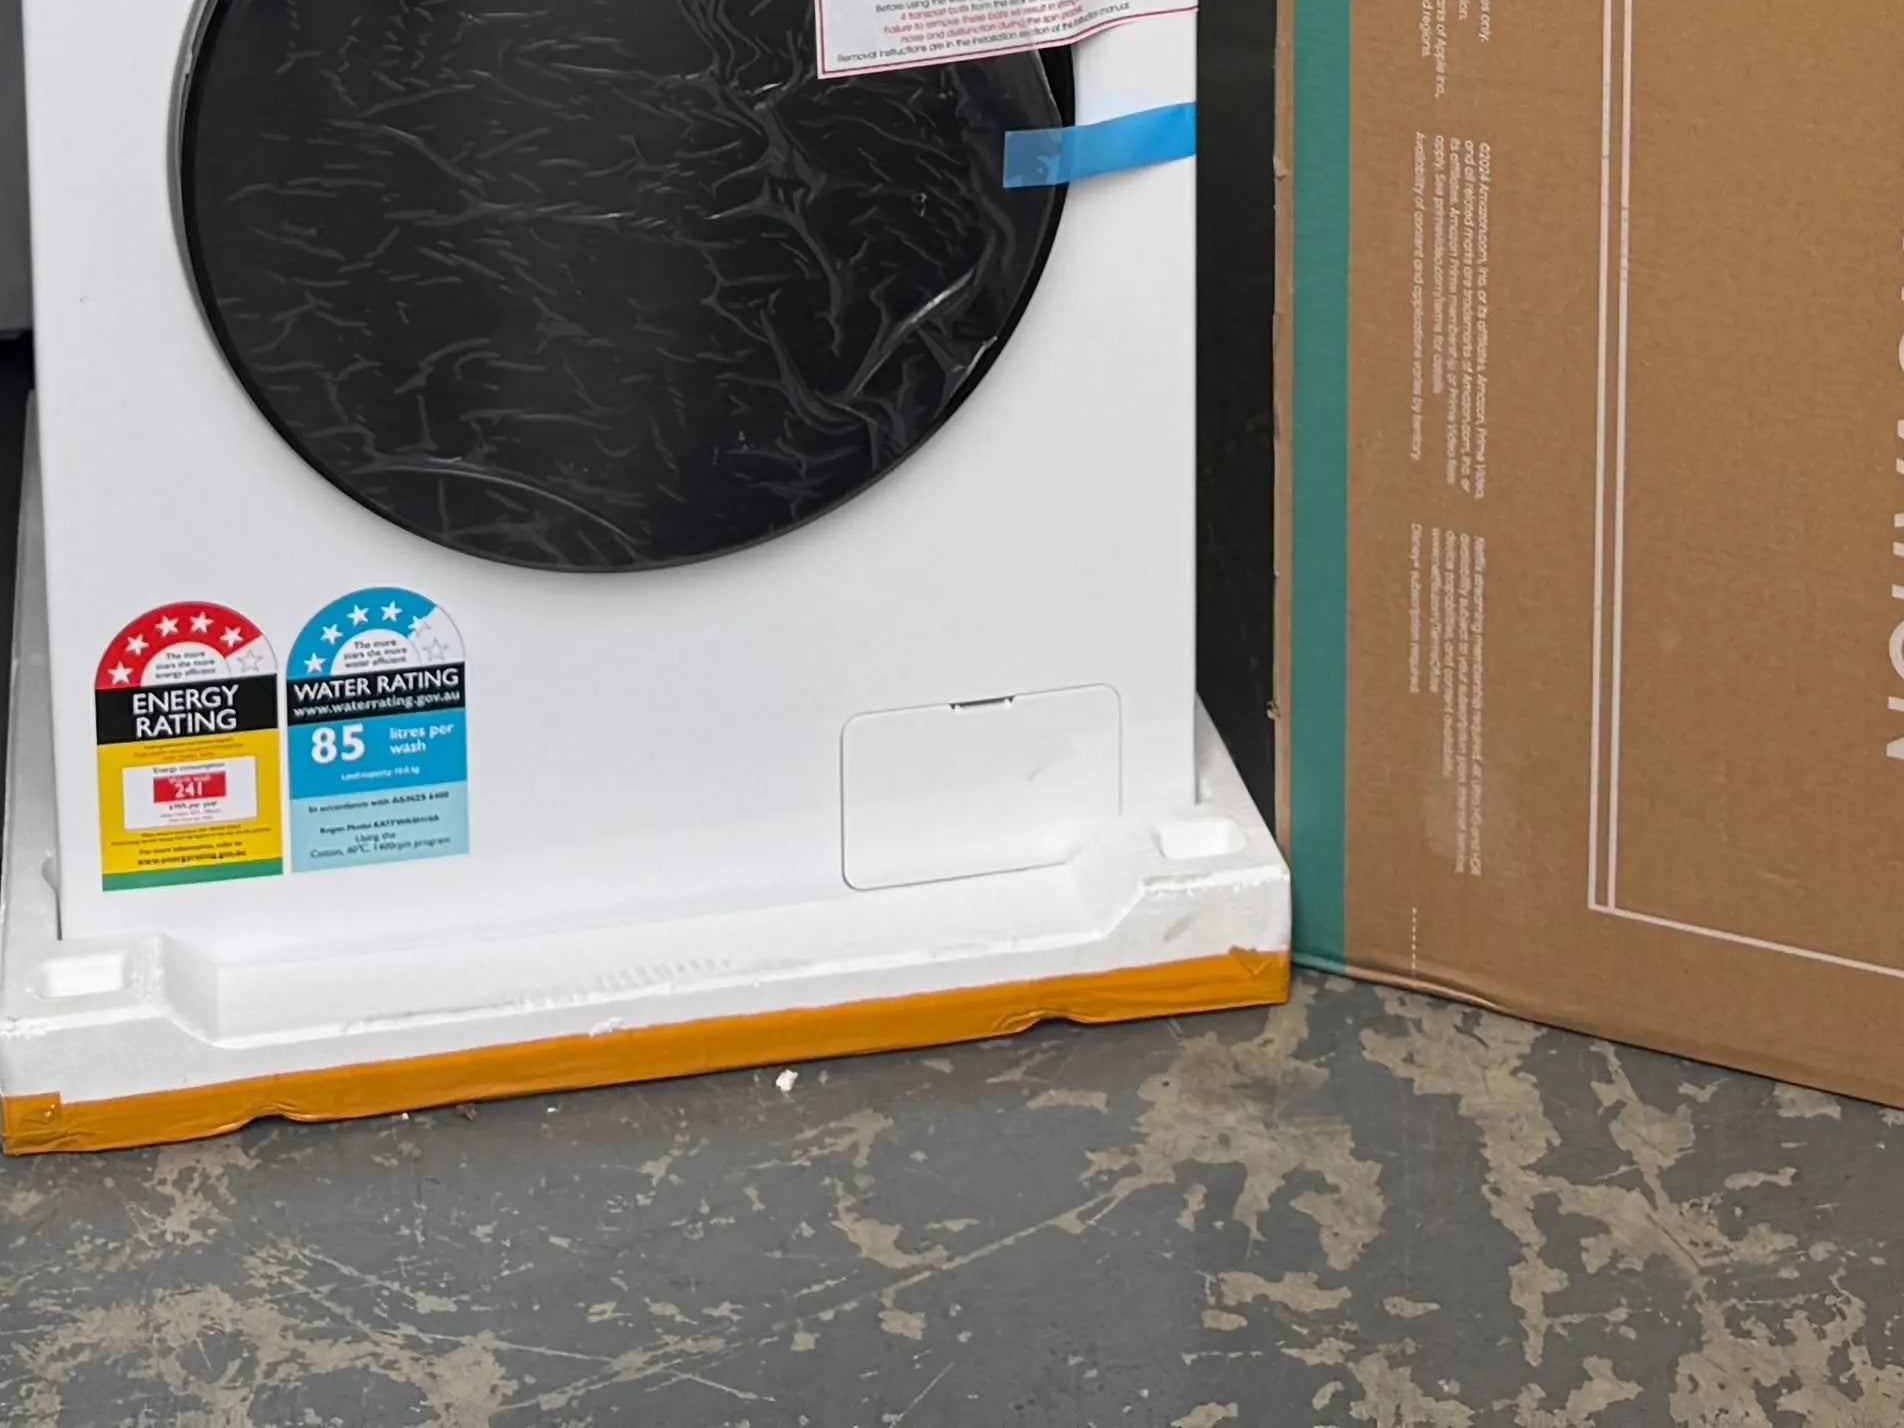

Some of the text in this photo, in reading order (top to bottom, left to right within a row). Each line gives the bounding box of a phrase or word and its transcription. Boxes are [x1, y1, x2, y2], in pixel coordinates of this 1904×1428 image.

[294, 668, 459, 701] WATER RATING
[132, 684, 239, 715] ENERGY
[293, 692, 461, 719] www.waterrating.gov.au
[136, 709, 237, 738] RATING
[311, 723, 454, 763] 85 litres per
[390, 739, 426, 755] wash
[174, 783, 203, 799] 241
